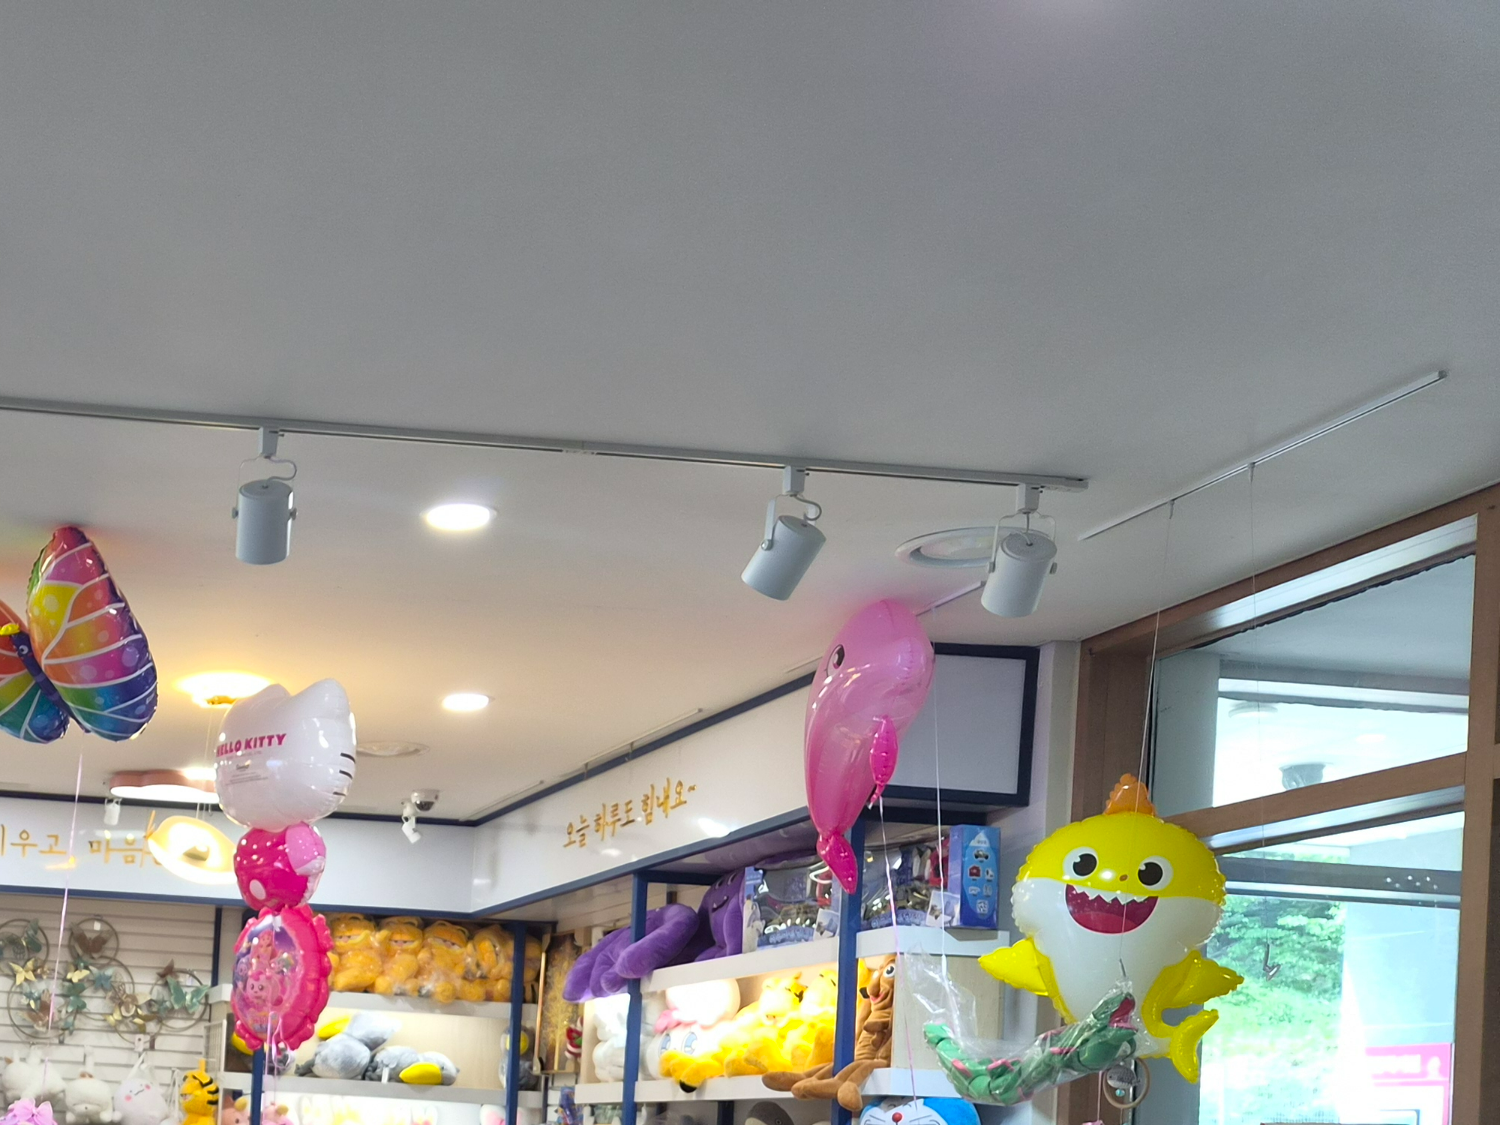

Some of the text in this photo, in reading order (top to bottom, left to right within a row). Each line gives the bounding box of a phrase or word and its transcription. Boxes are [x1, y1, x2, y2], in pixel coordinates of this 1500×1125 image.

[216, 739, 242, 757] HELLO
[244, 733, 286, 750] KITTY
[563, 814, 590, 848] 오늘
[594, 799, 636, 841] 하루도
[88, 829, 162, 866] 마음
